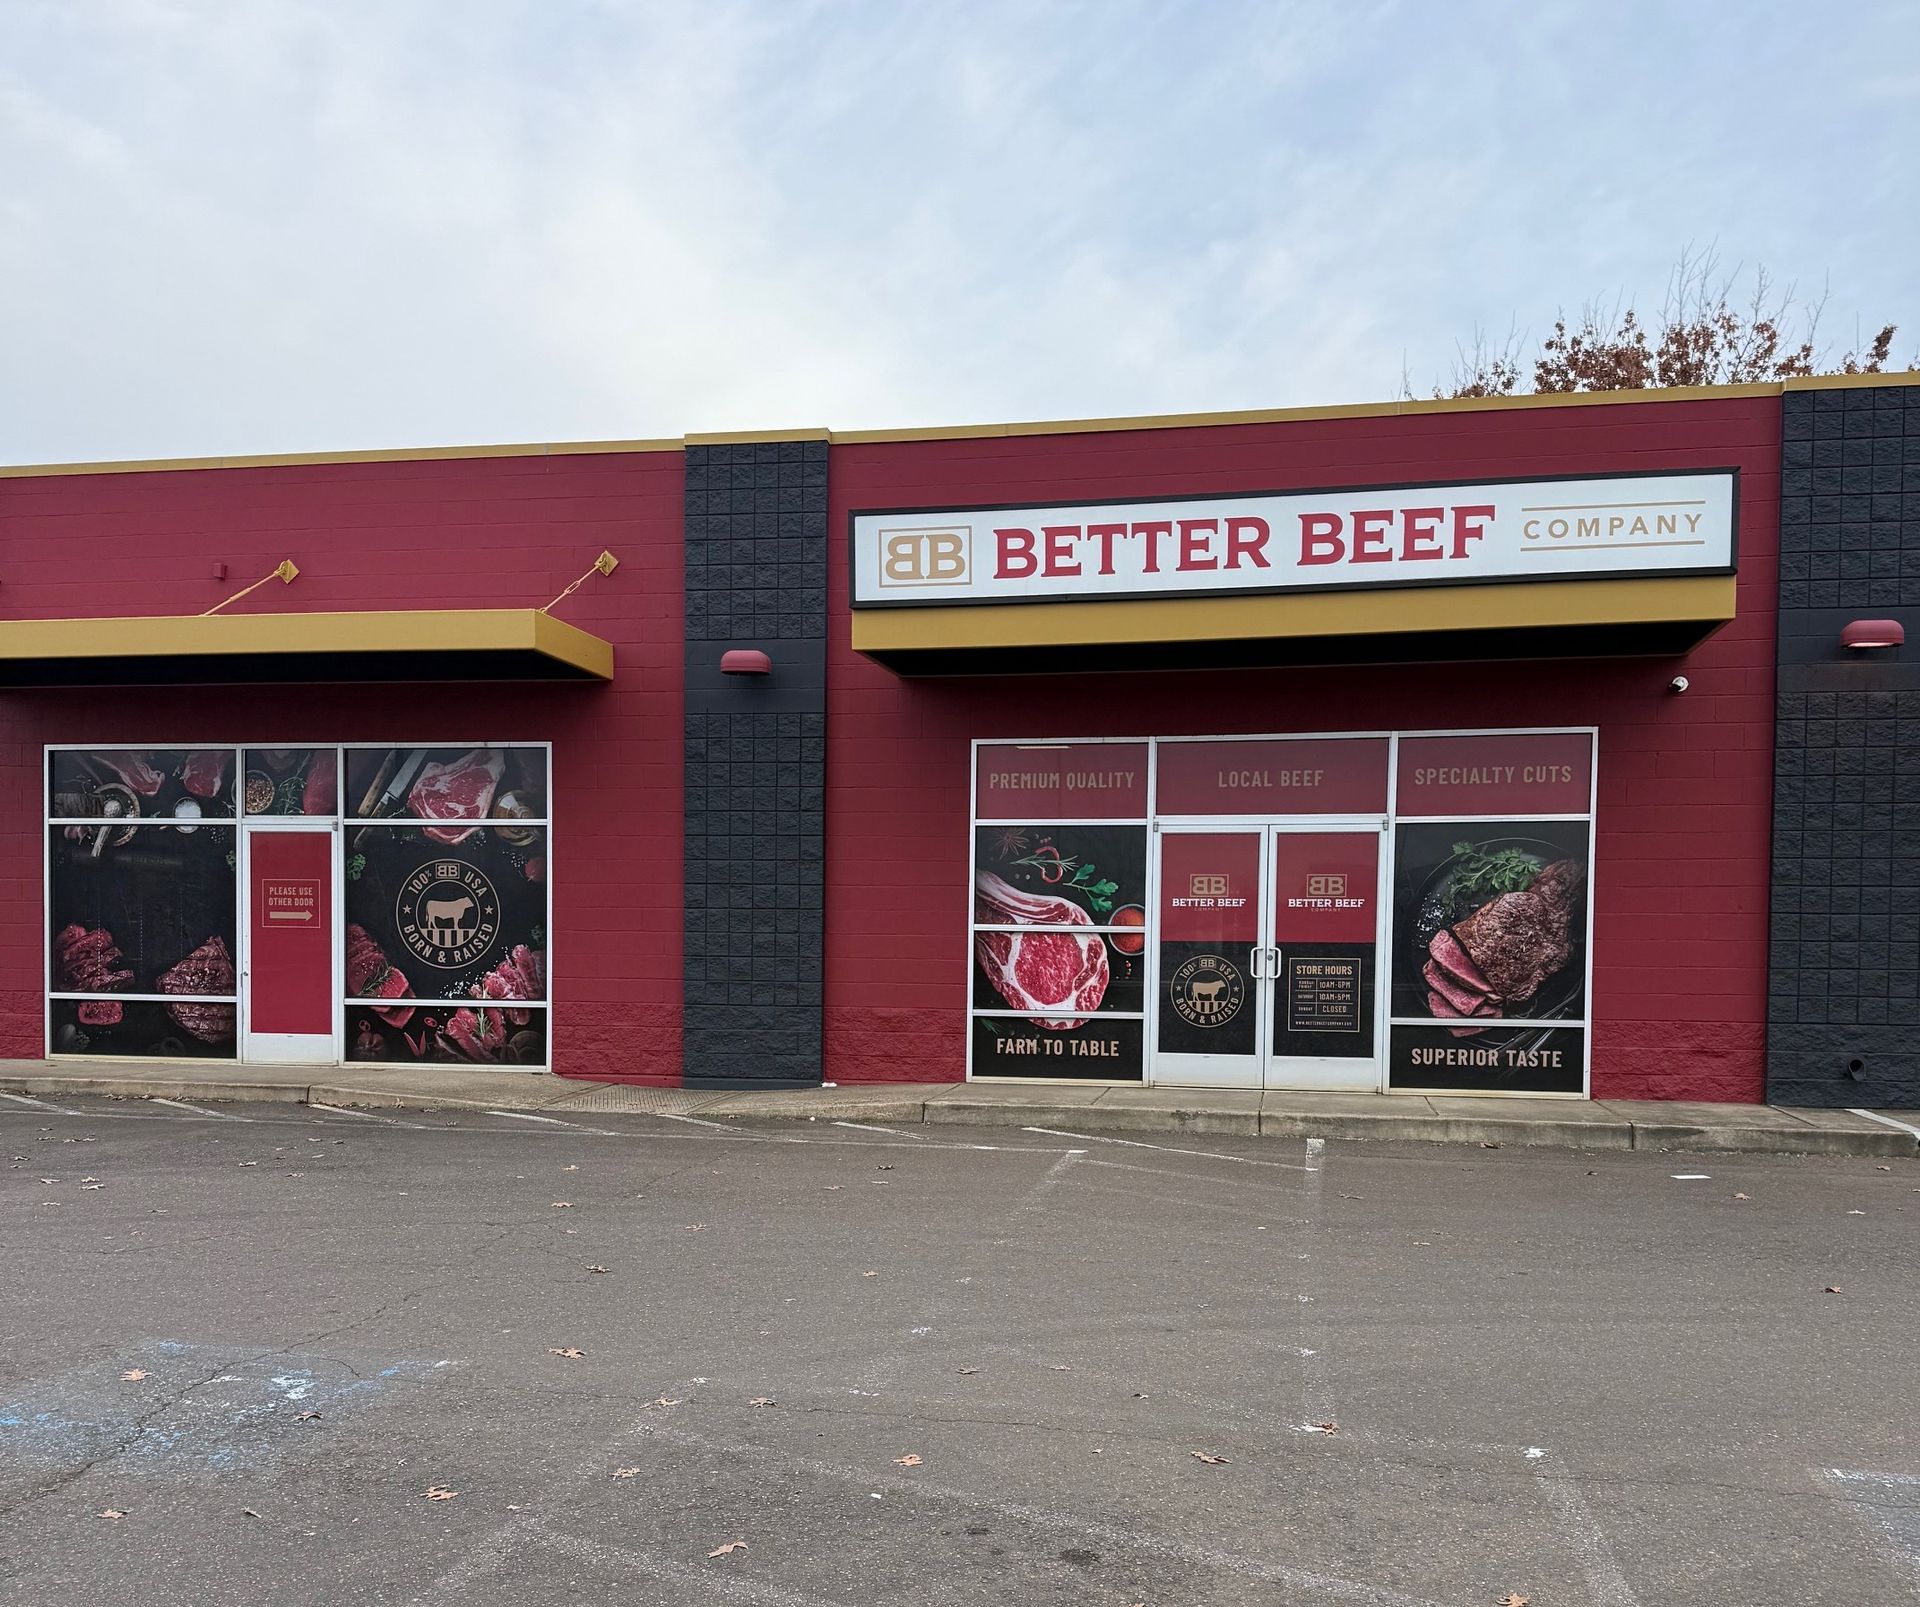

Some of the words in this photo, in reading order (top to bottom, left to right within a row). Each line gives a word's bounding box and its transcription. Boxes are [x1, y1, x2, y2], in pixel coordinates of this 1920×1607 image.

[1523, 513, 1703, 540] COMPANY
[992, 515, 1271, 580] BETTER
[1296, 505, 1496, 567] BEEF
[989, 772, 1061, 789] PREMIUM
[1066, 771, 1135, 789] QUALITY
[1218, 770, 1273, 787] LOCAL
[1280, 769, 1324, 786] BEEF
[1414, 767, 1516, 785] SPECIALTY
[1523, 765, 1572, 783] CUTS
[269, 886, 297, 896] PLEASE
[299, 886, 313, 896] USE
[408, 869, 432, 895] 100%
[464, 871, 488, 897] USA
[268, 897, 292, 906] OTHER
[294, 897, 314, 907] DOOR
[1172, 898, 1214, 907] BETTER
[1217, 898, 1247, 907] BEEF
[1288, 898, 1332, 908] BETTER
[1335, 898, 1365, 908] BEEF
[403, 924, 433, 958] BORN
[437, 950, 446, 963] &
[453, 923, 493, 963] RAISED
[1219, 963, 1236, 981] USA
[1296, 965, 1323, 975] STORE
[1324, 965, 1353, 975] HOURS
[1175, 997, 1197, 1020] BORN
[1199, 1015, 1206, 1024] &
[1210, 997, 1239, 1024] RAISED
[1322, 1005, 1347, 1013] CLOSED
[996, 1038, 1037, 1055] FARM
[1043, 1039, 1063, 1056] TO
[1069, 1040, 1120, 1057] TABLE
[1411, 1048, 1499, 1066] SUPERIOR
[1506, 1050, 1562, 1068] TASTE
